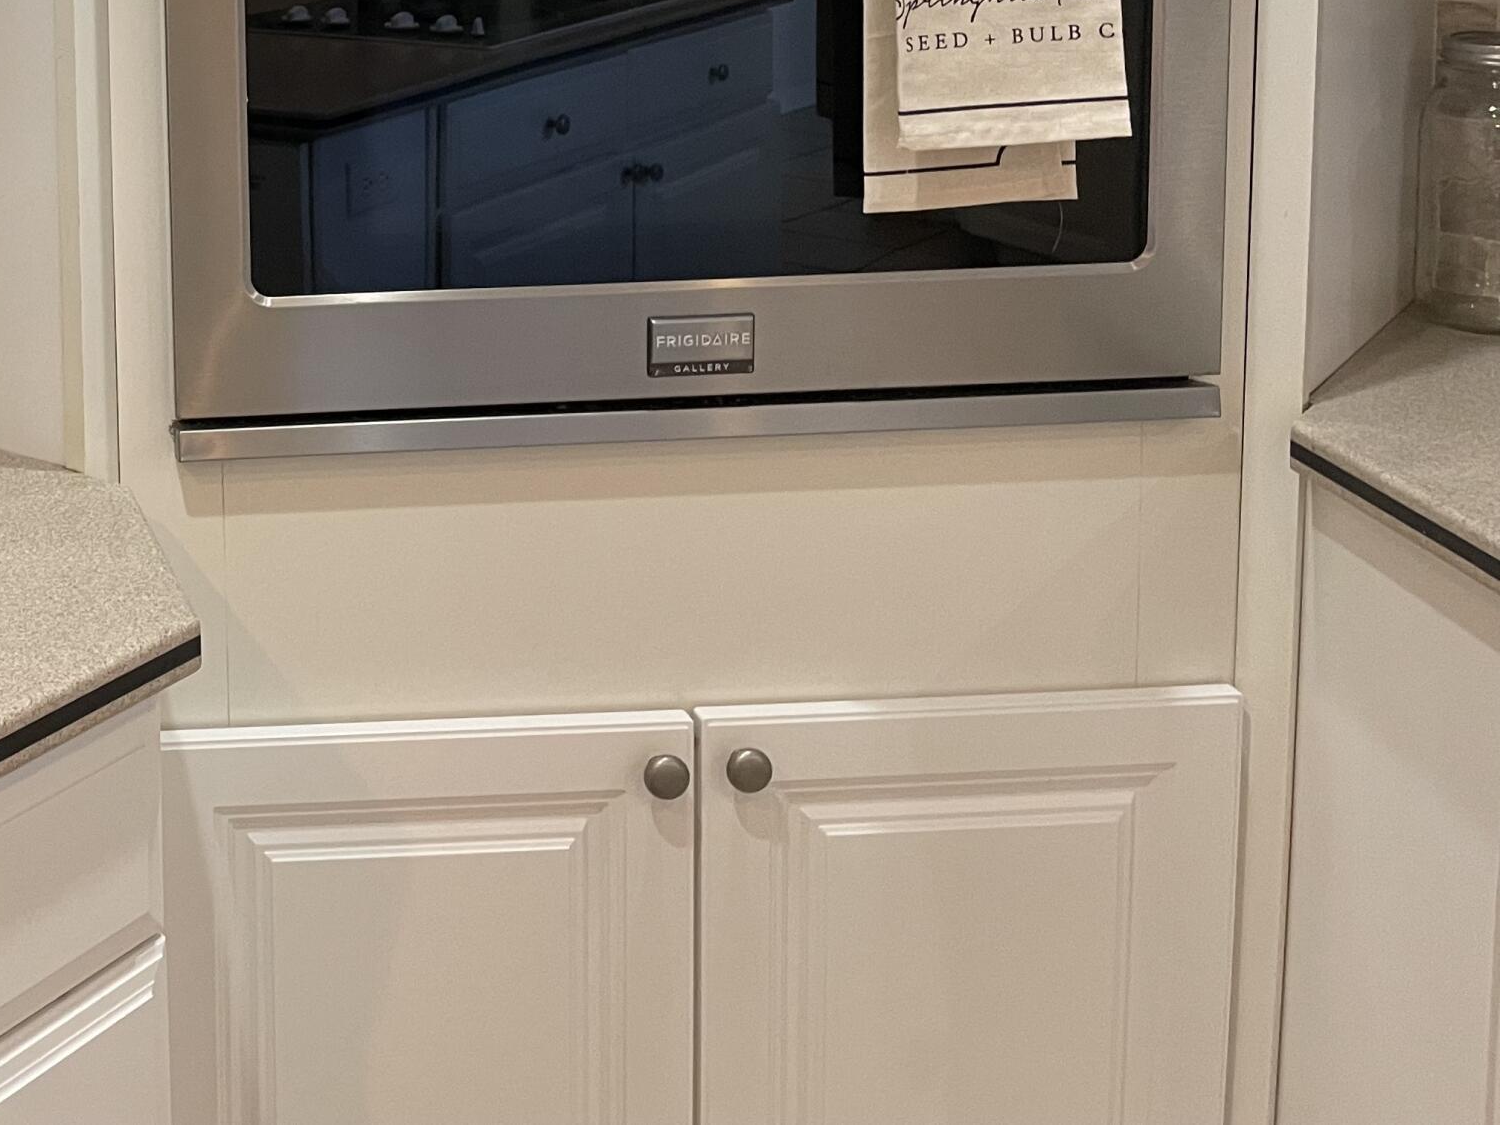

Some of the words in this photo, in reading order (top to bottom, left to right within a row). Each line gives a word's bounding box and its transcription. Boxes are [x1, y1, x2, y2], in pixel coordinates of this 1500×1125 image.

[906, 32, 969, 53] SEED
[984, 33, 997, 46] +
[1012, 24, 1082, 45] BULB
[1099, 22, 1116, 39] C
[656, 332, 751, 349] FRIGIDAIRE
[673, 362, 730, 373] GALLERY
